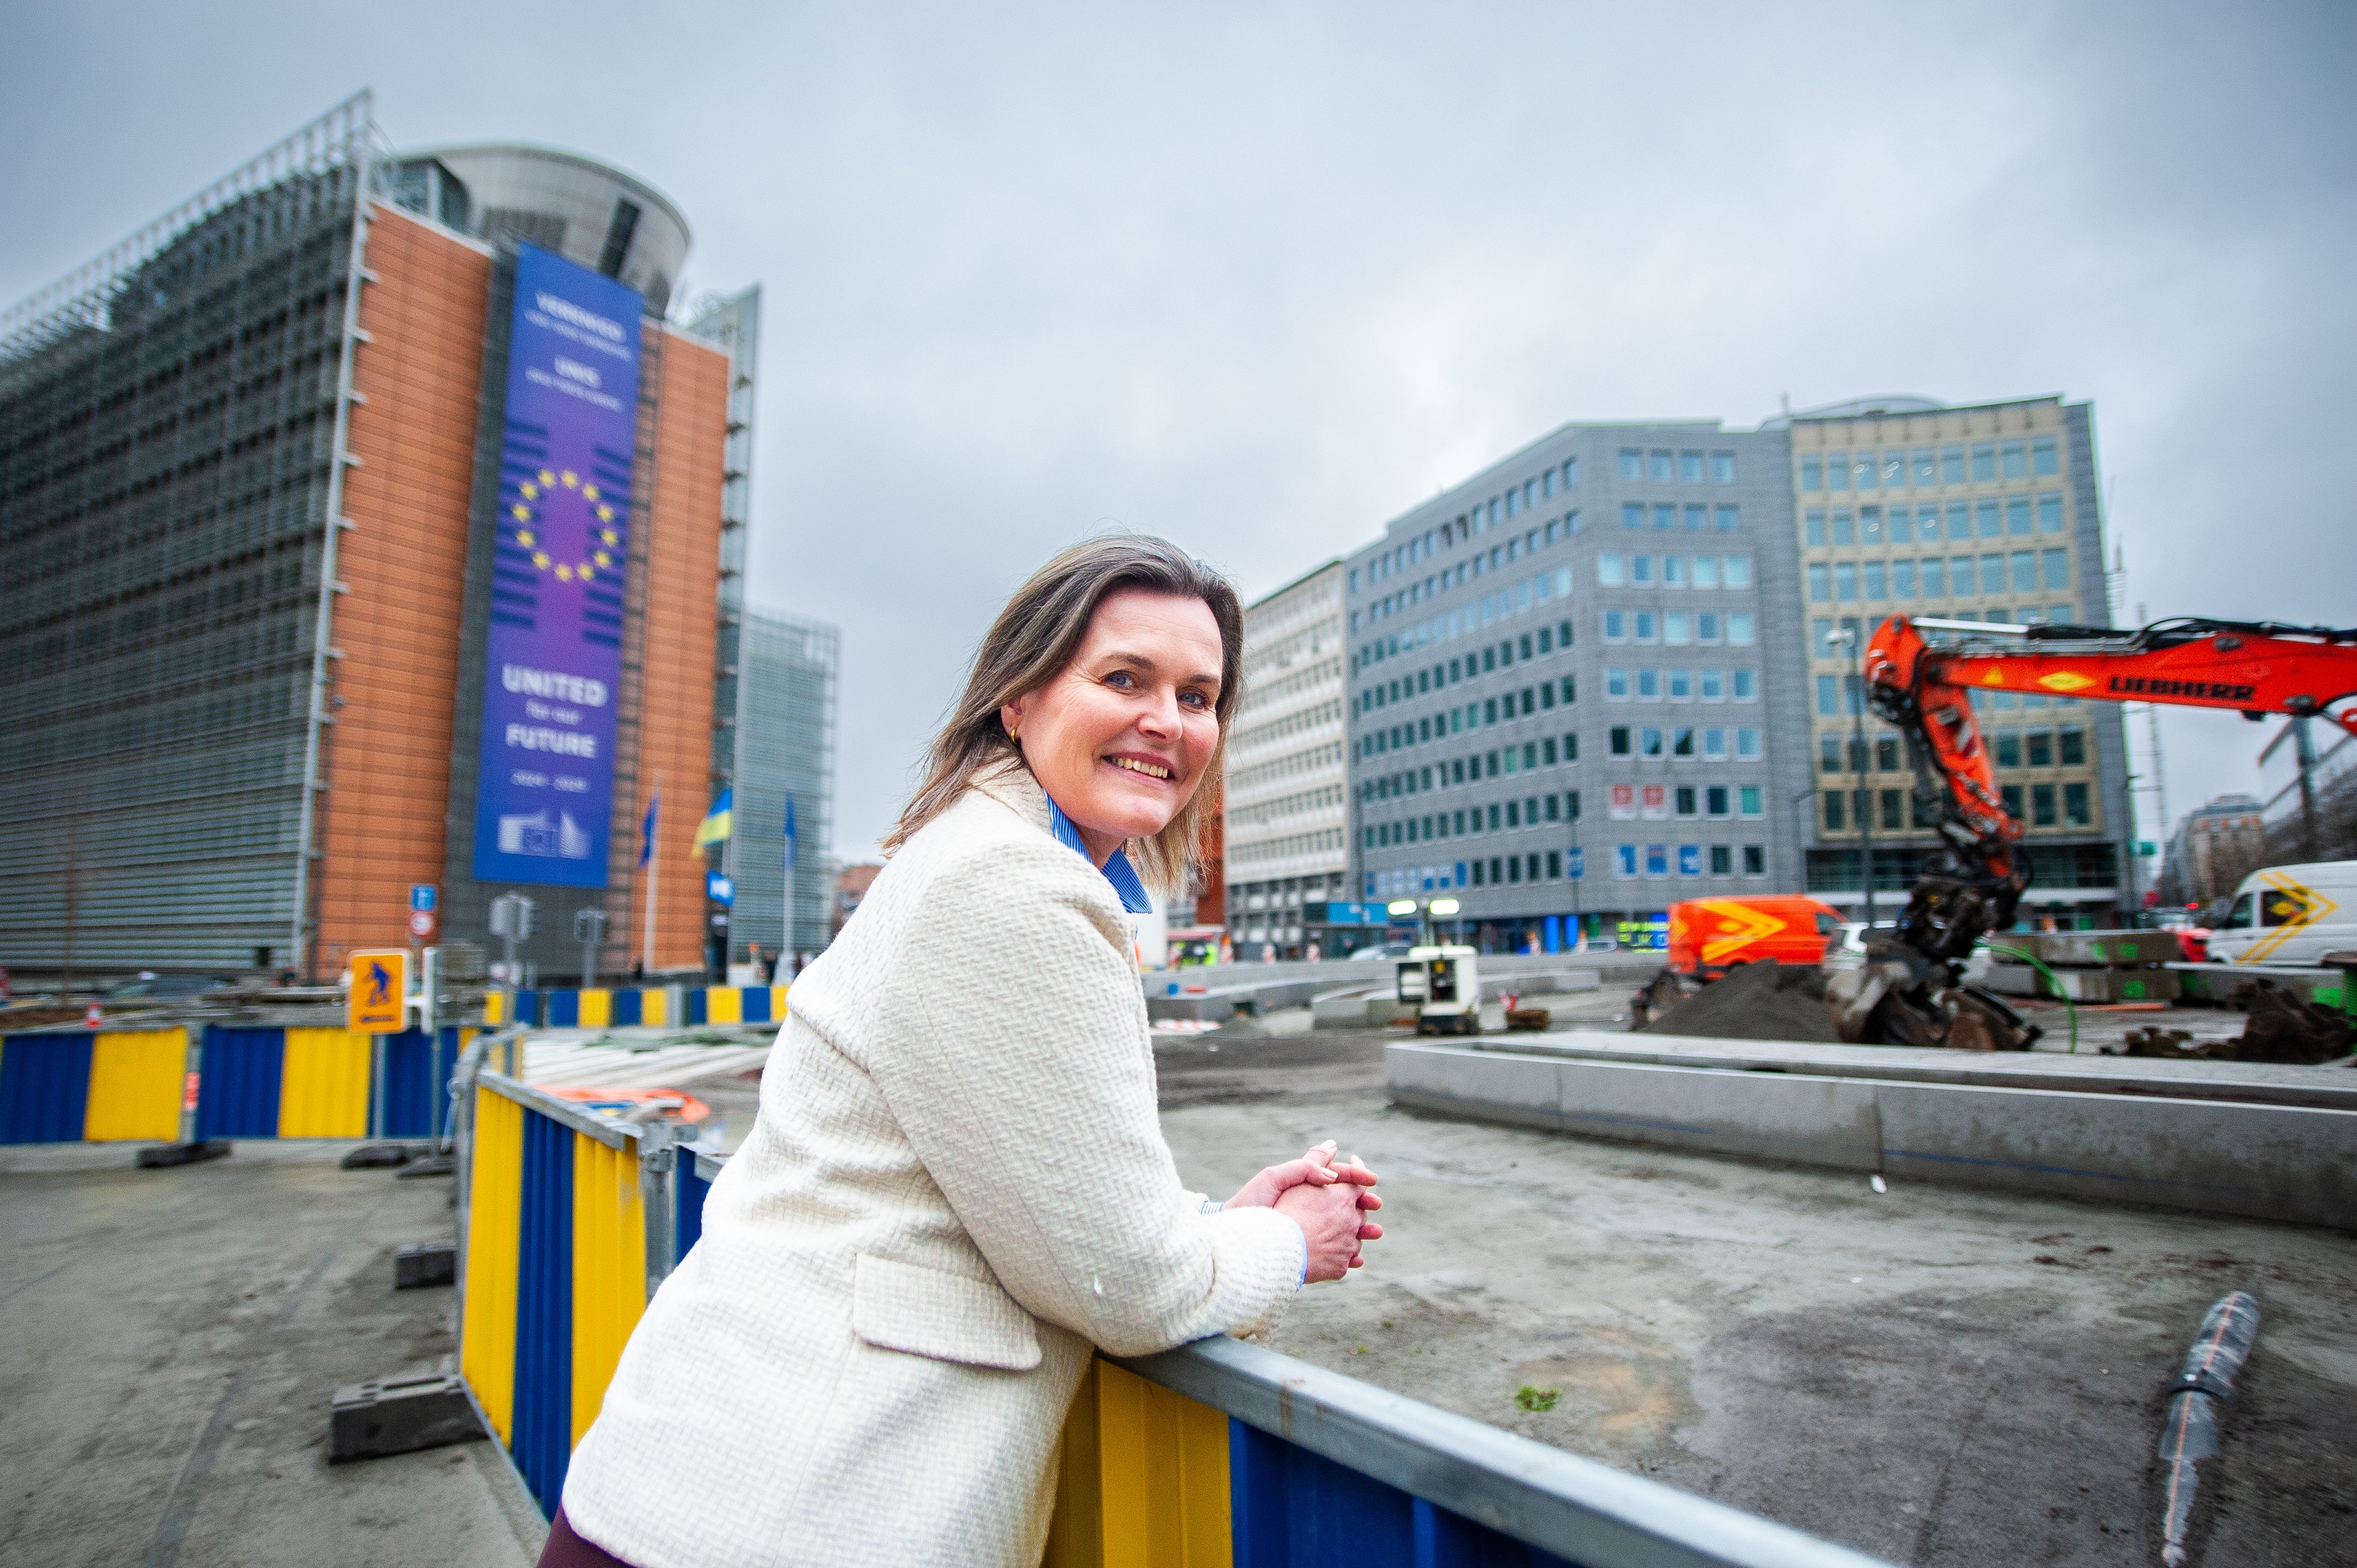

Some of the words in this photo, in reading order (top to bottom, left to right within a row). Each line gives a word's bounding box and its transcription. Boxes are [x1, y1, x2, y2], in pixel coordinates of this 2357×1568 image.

[502, 664, 608, 706] UNITED
[2110, 676, 2256, 700] LIEBHERR
[506, 723, 598, 759] FUTURE
